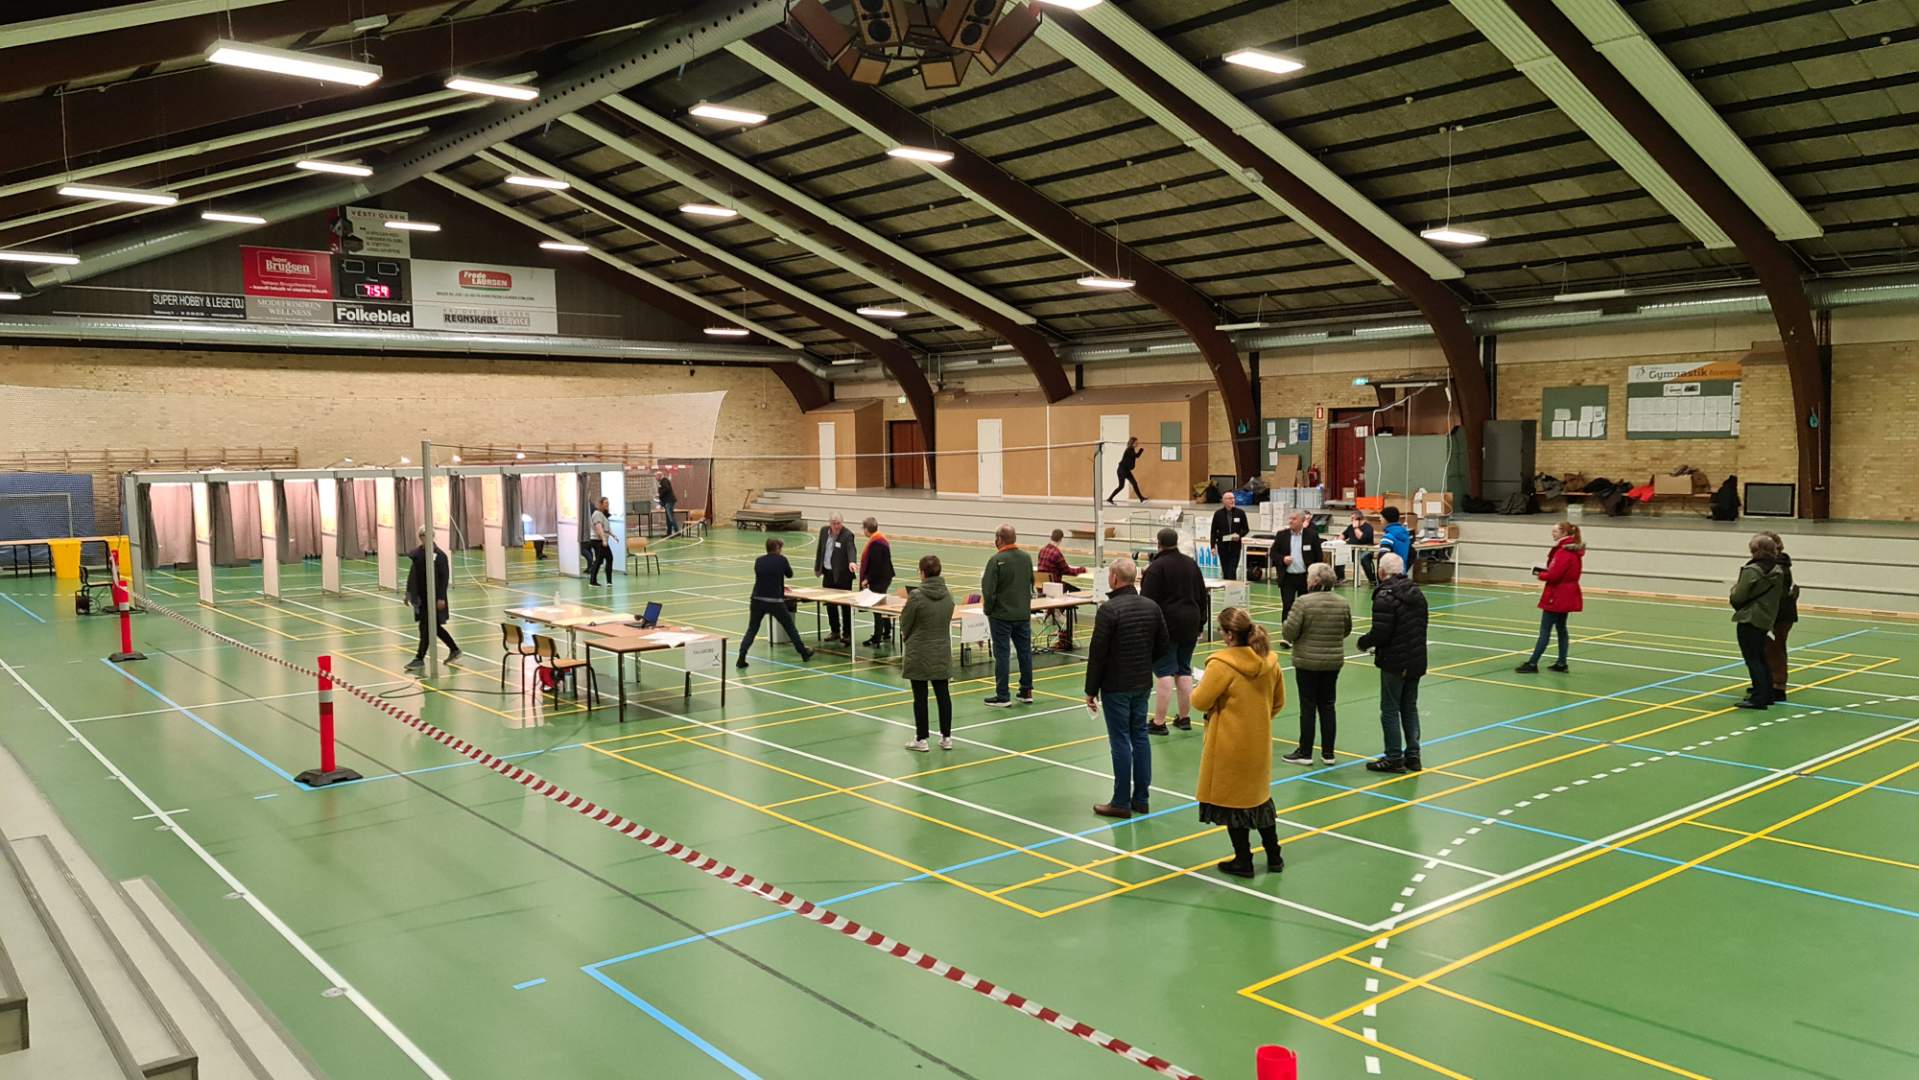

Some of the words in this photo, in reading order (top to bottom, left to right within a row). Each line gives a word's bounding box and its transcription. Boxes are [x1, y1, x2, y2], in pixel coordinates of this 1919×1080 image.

[265, 260, 310, 274] Brugsen
[463, 271, 487, 279] Frode
[471, 278, 508, 286] LAURSEN
[364, 284, 390, 298] 7:59
[152, 293, 178, 306] SUPER
[179, 295, 205, 307] HOBBY
[205, 297, 212, 307] &
[212, 297, 245, 309] LEGETØJ
[268, 308, 313, 317] WELLNESS
[336, 307, 411, 324] Folkeblad
[1648, 363, 1708, 380] Gymnastik
